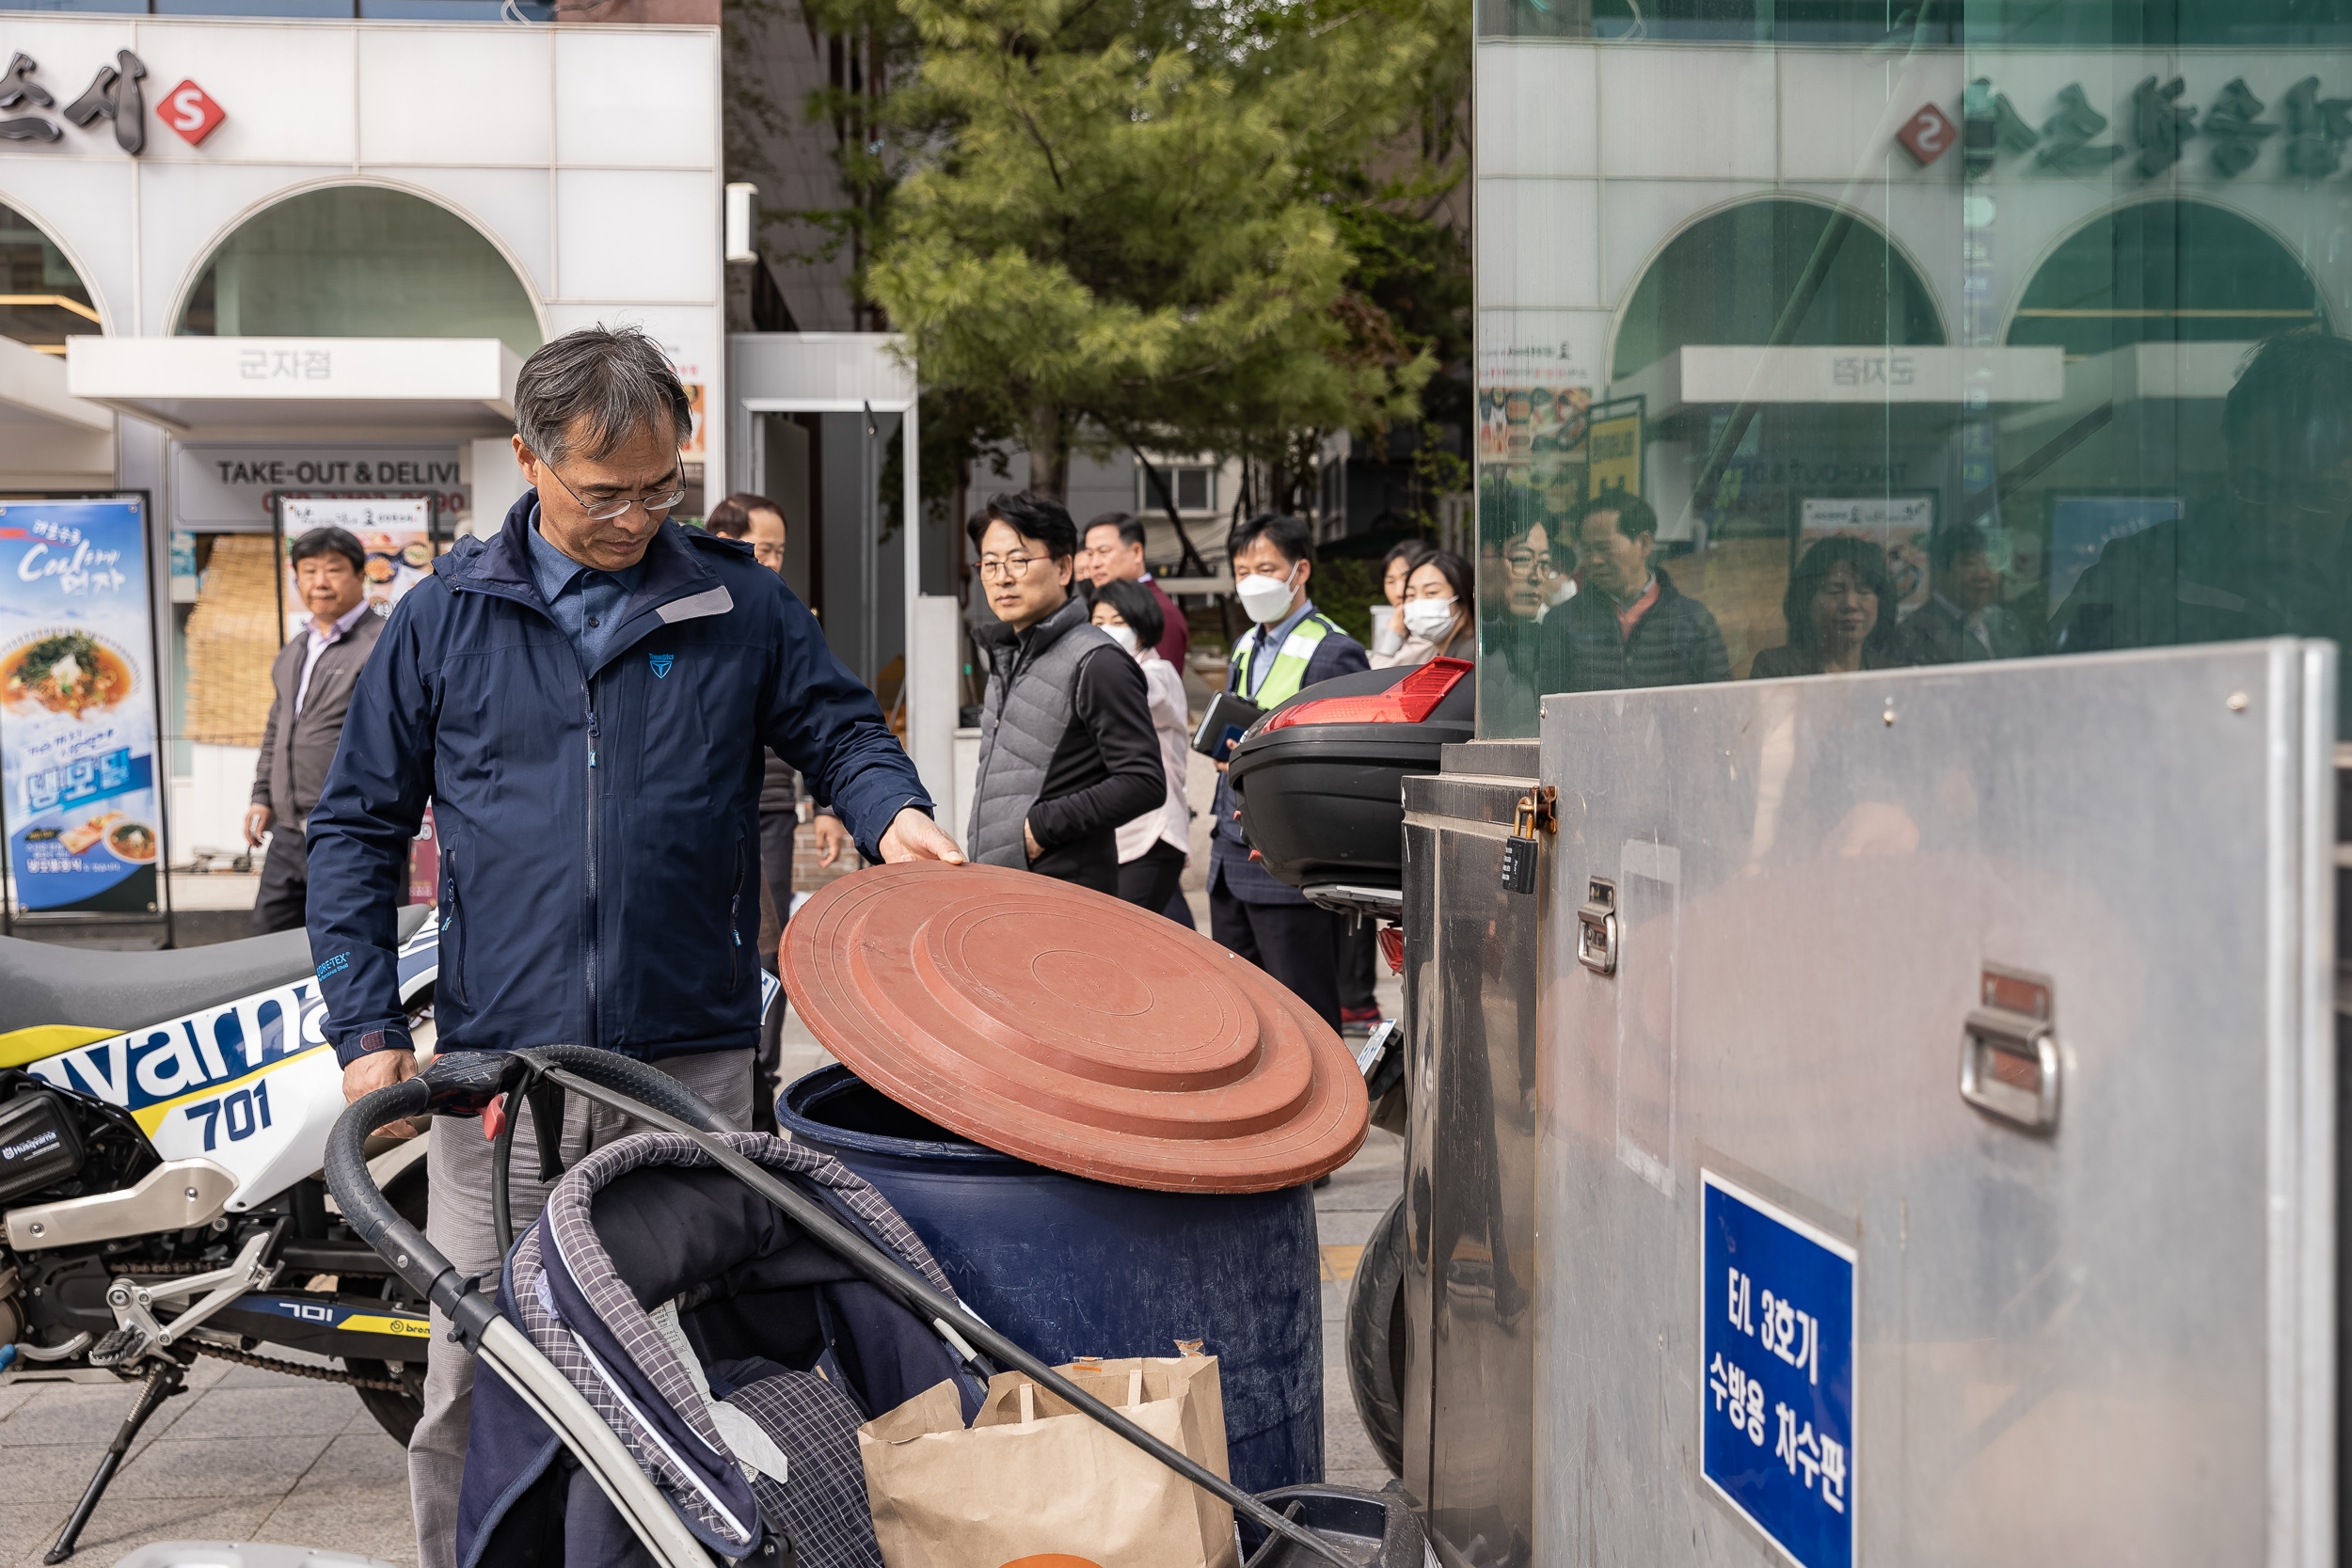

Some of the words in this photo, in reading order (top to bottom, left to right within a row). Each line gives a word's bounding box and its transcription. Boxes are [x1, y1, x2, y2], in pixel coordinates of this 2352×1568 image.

[173, 88, 206, 132] S
[240, 349, 331, 380] 군자점
[218, 461, 349, 484] TAKE-OUT
[354, 461, 373, 484] &
[184, 1079, 272, 1152] 701
[278, 1302, 333, 1323] 701
[1728, 1266, 1755, 1337] E/L
[1760, 1289, 1818, 1386] 3호기
[1709, 1351, 1766, 1447] 수방용
[1774, 1401, 1846, 1514] 차수판
